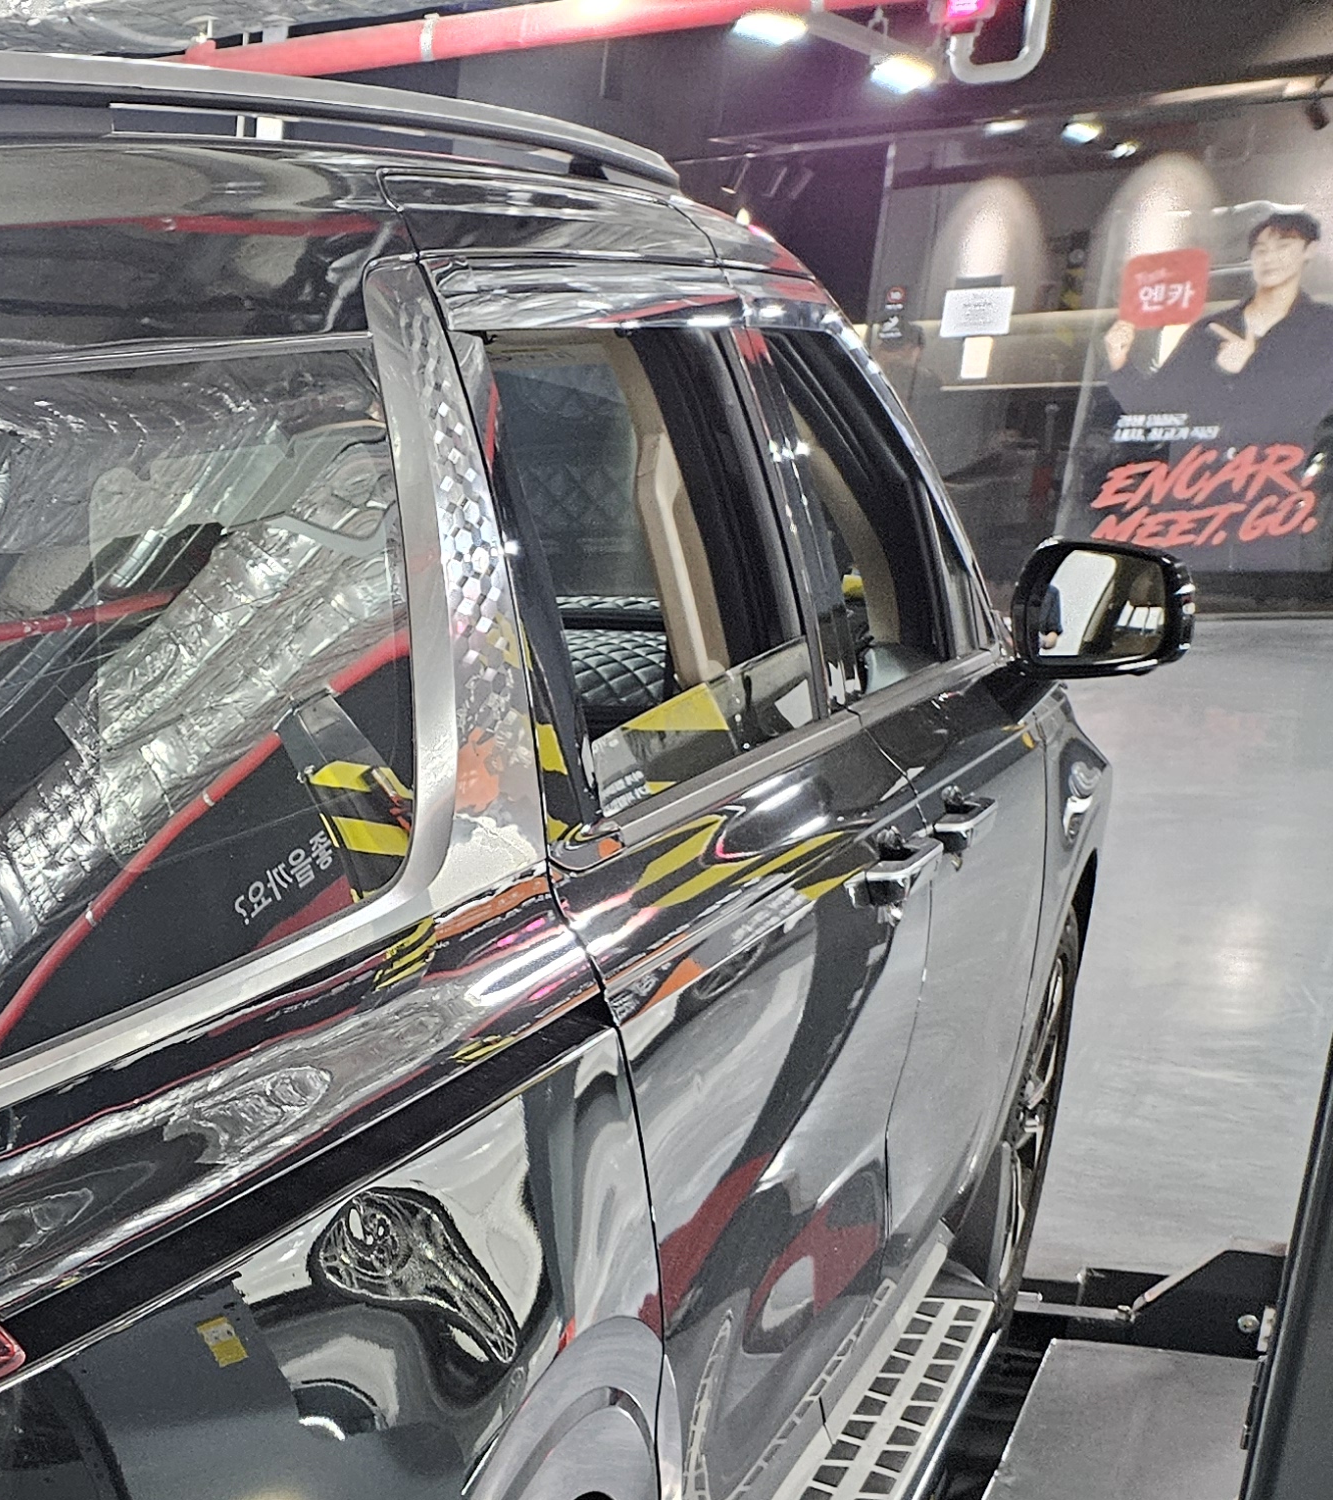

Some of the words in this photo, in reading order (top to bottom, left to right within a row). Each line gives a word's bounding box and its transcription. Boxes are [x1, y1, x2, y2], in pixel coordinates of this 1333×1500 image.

[1139, 280, 1196, 312] 엔카
[1090, 501, 1247, 548] MEET.
[1239, 490, 1318, 542] GO.
